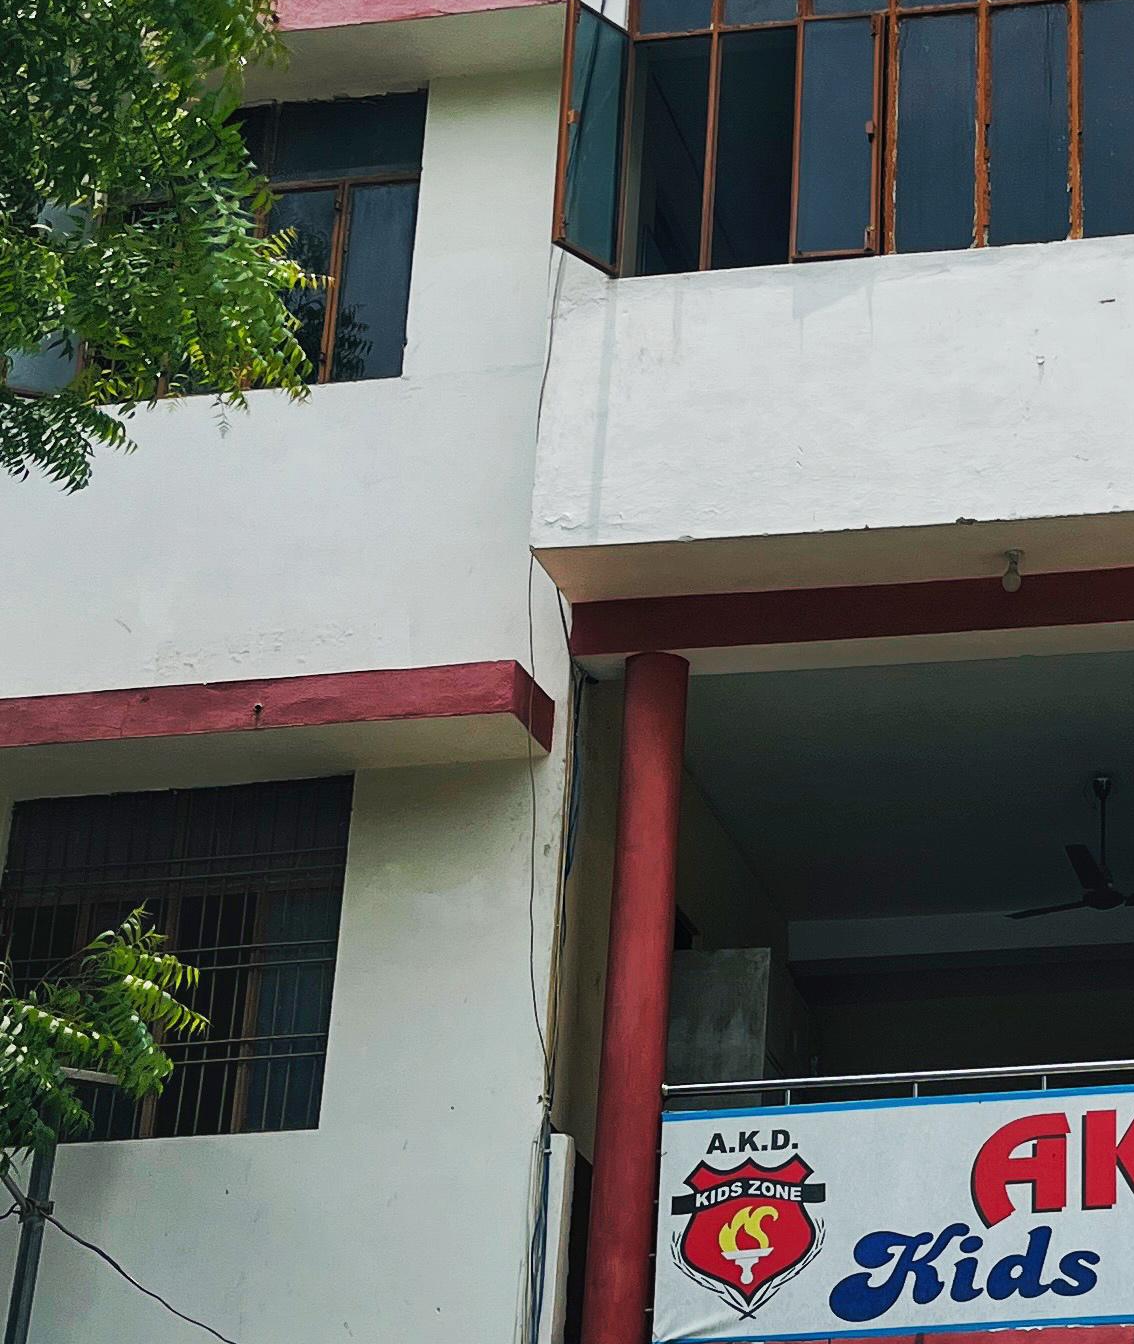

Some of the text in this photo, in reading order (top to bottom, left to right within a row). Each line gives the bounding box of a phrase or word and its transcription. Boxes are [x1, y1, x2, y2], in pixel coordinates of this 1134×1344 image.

[706, 1129, 799, 1155] A.K.D.
[695, 1180, 802, 1208] KIDS ZONE
[828, 1224, 1100, 1322] Kids
